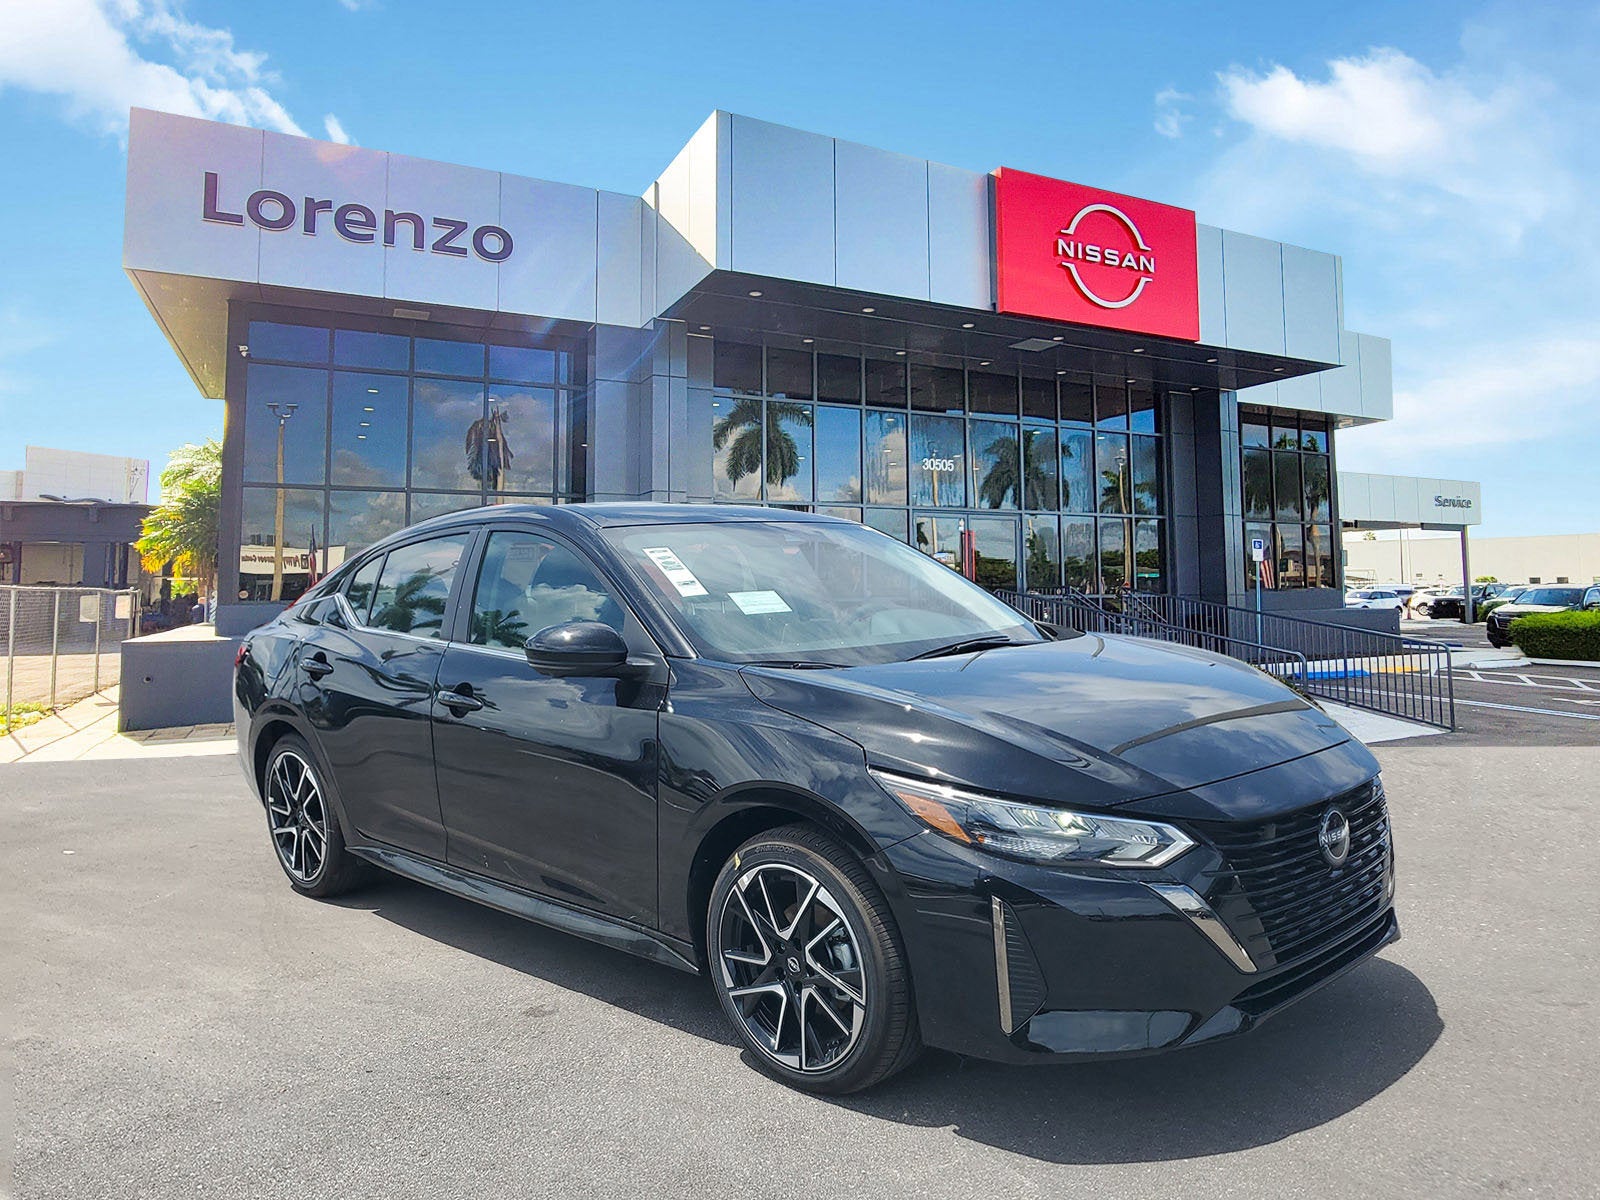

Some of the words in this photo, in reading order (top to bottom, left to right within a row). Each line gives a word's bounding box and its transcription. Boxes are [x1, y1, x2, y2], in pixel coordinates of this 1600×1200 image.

[203, 171, 514, 262] Lorenzo
[1057, 238, 1155, 273] NISSAN
[922, 457, 955, 472] 30505
[1434, 495, 1472, 509] Service
